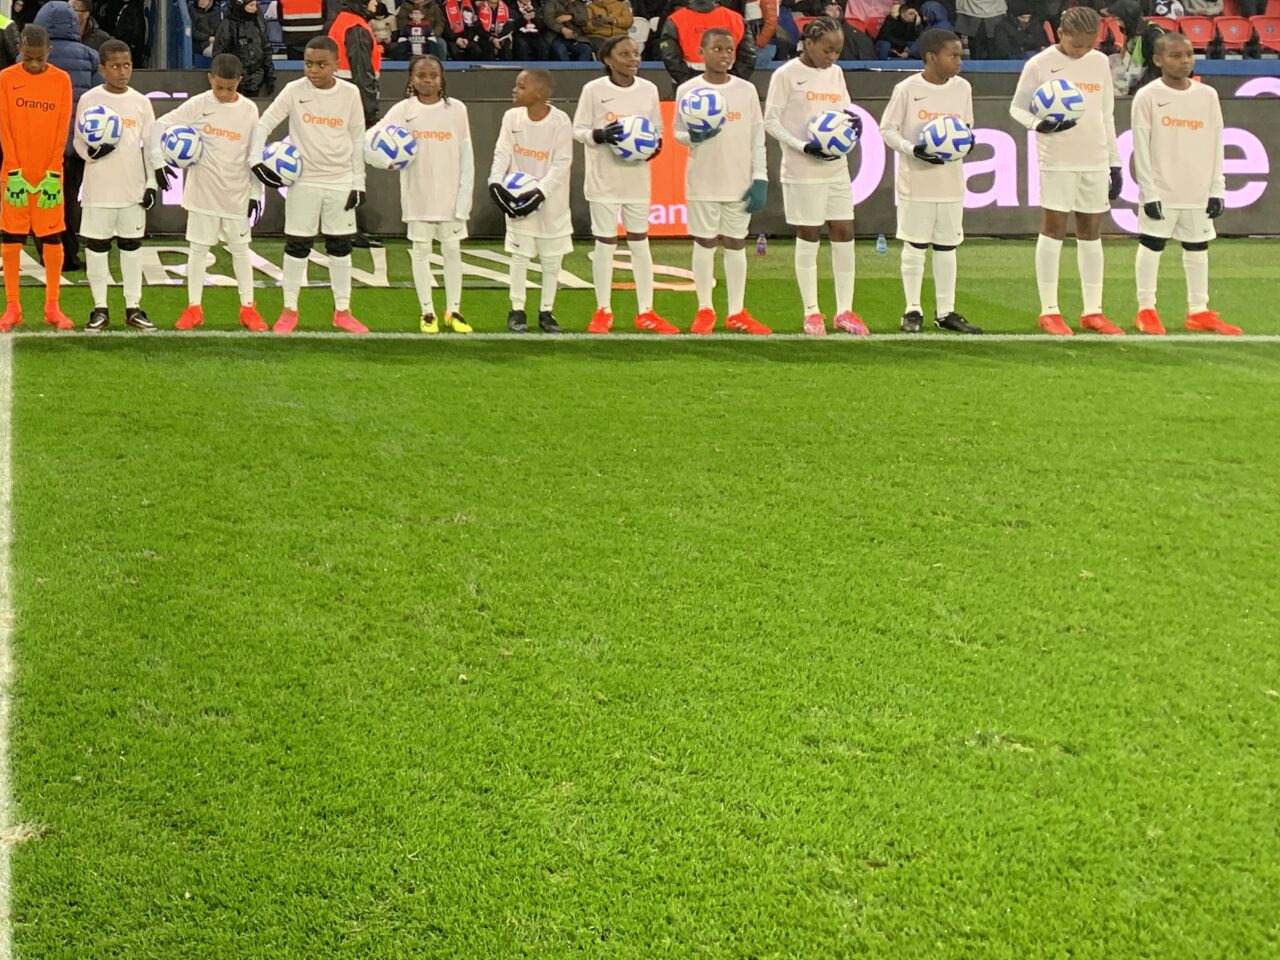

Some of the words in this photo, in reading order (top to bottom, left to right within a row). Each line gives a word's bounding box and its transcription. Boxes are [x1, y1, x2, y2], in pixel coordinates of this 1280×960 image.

[16, 97, 56, 111] Orange
[302, 113, 344, 127] Orange
[1161, 116, 1204, 130] Orange
[203, 124, 241, 141] Orange
